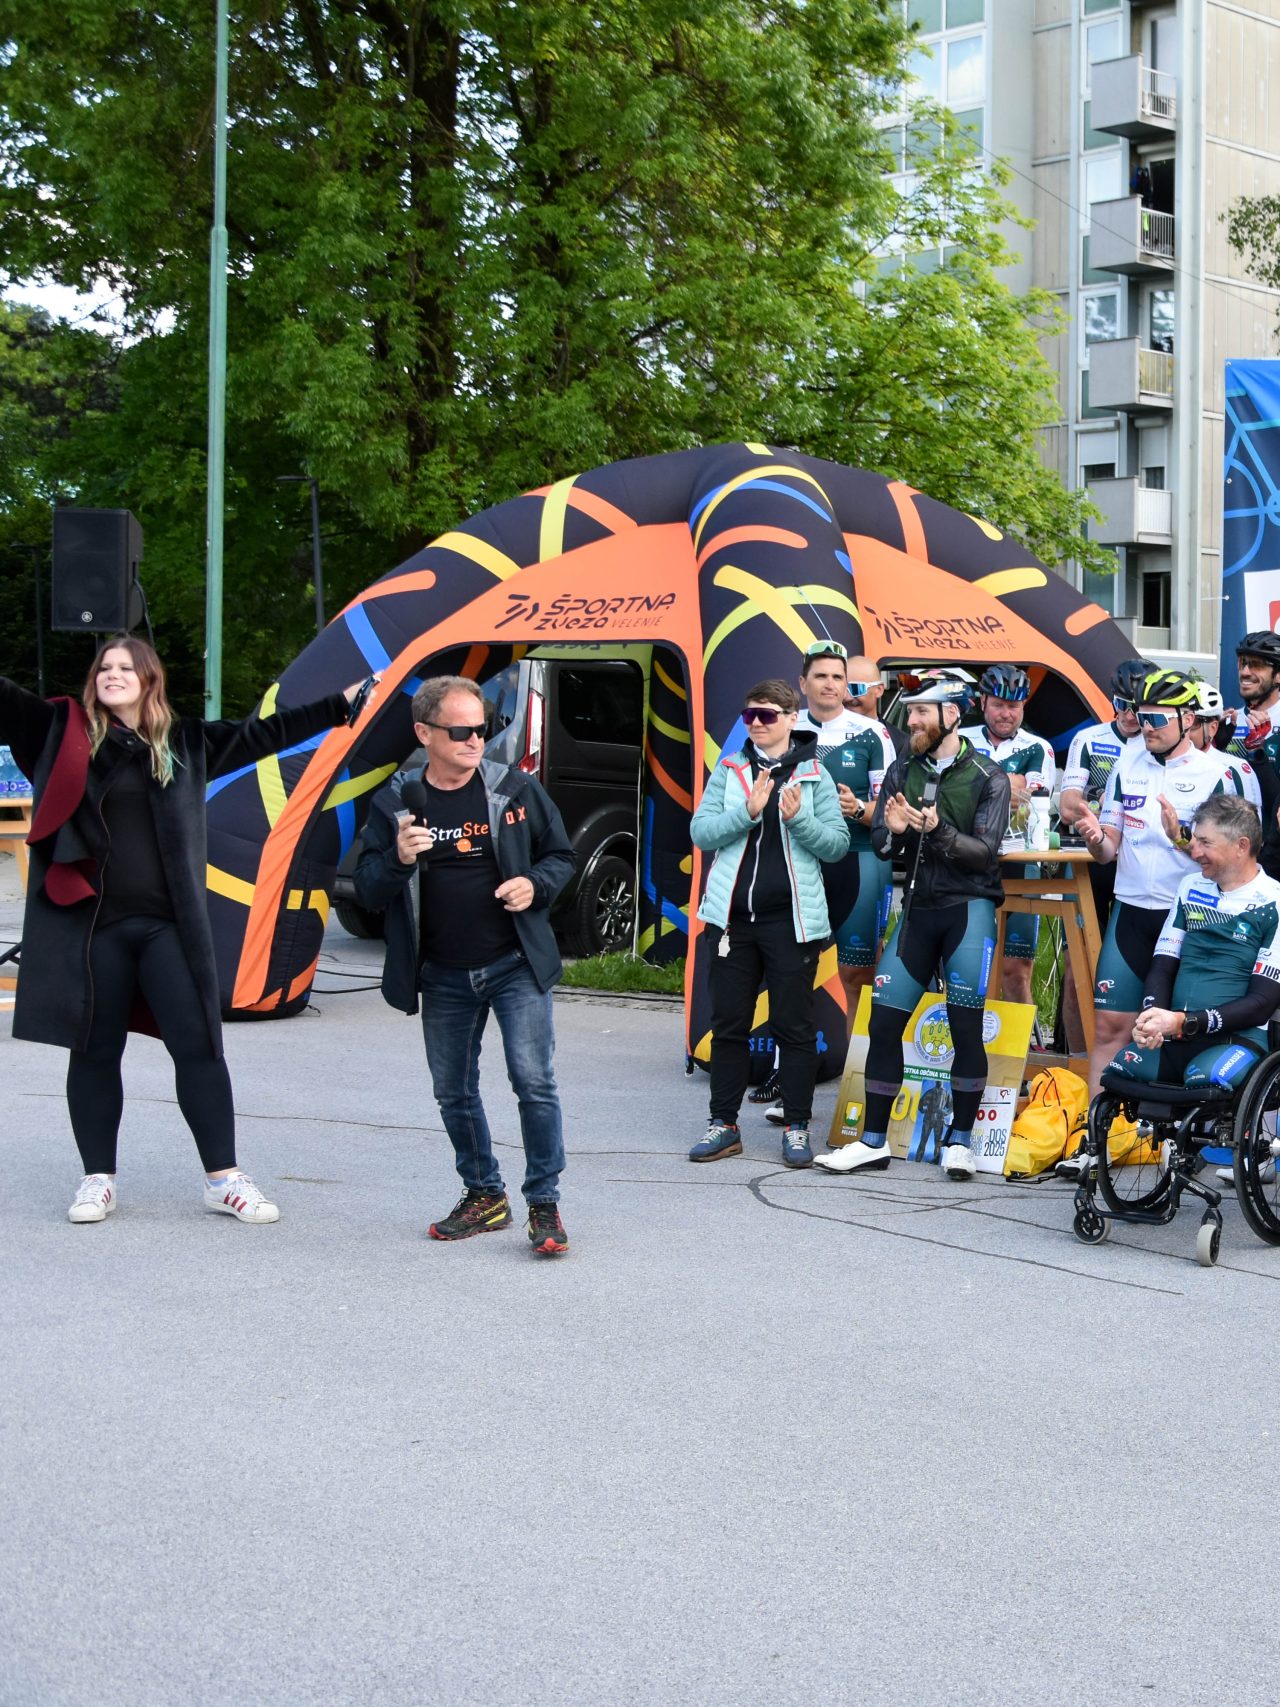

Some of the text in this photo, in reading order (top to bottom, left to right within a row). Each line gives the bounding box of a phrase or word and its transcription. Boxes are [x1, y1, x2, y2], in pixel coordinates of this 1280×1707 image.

[1260, 964, 1280, 980] JUB
[1218, 1053, 1242, 1078] SPARKASSE
[990, 1129, 1008, 1144] DOS
[984, 1141, 1005, 1156] 2025
